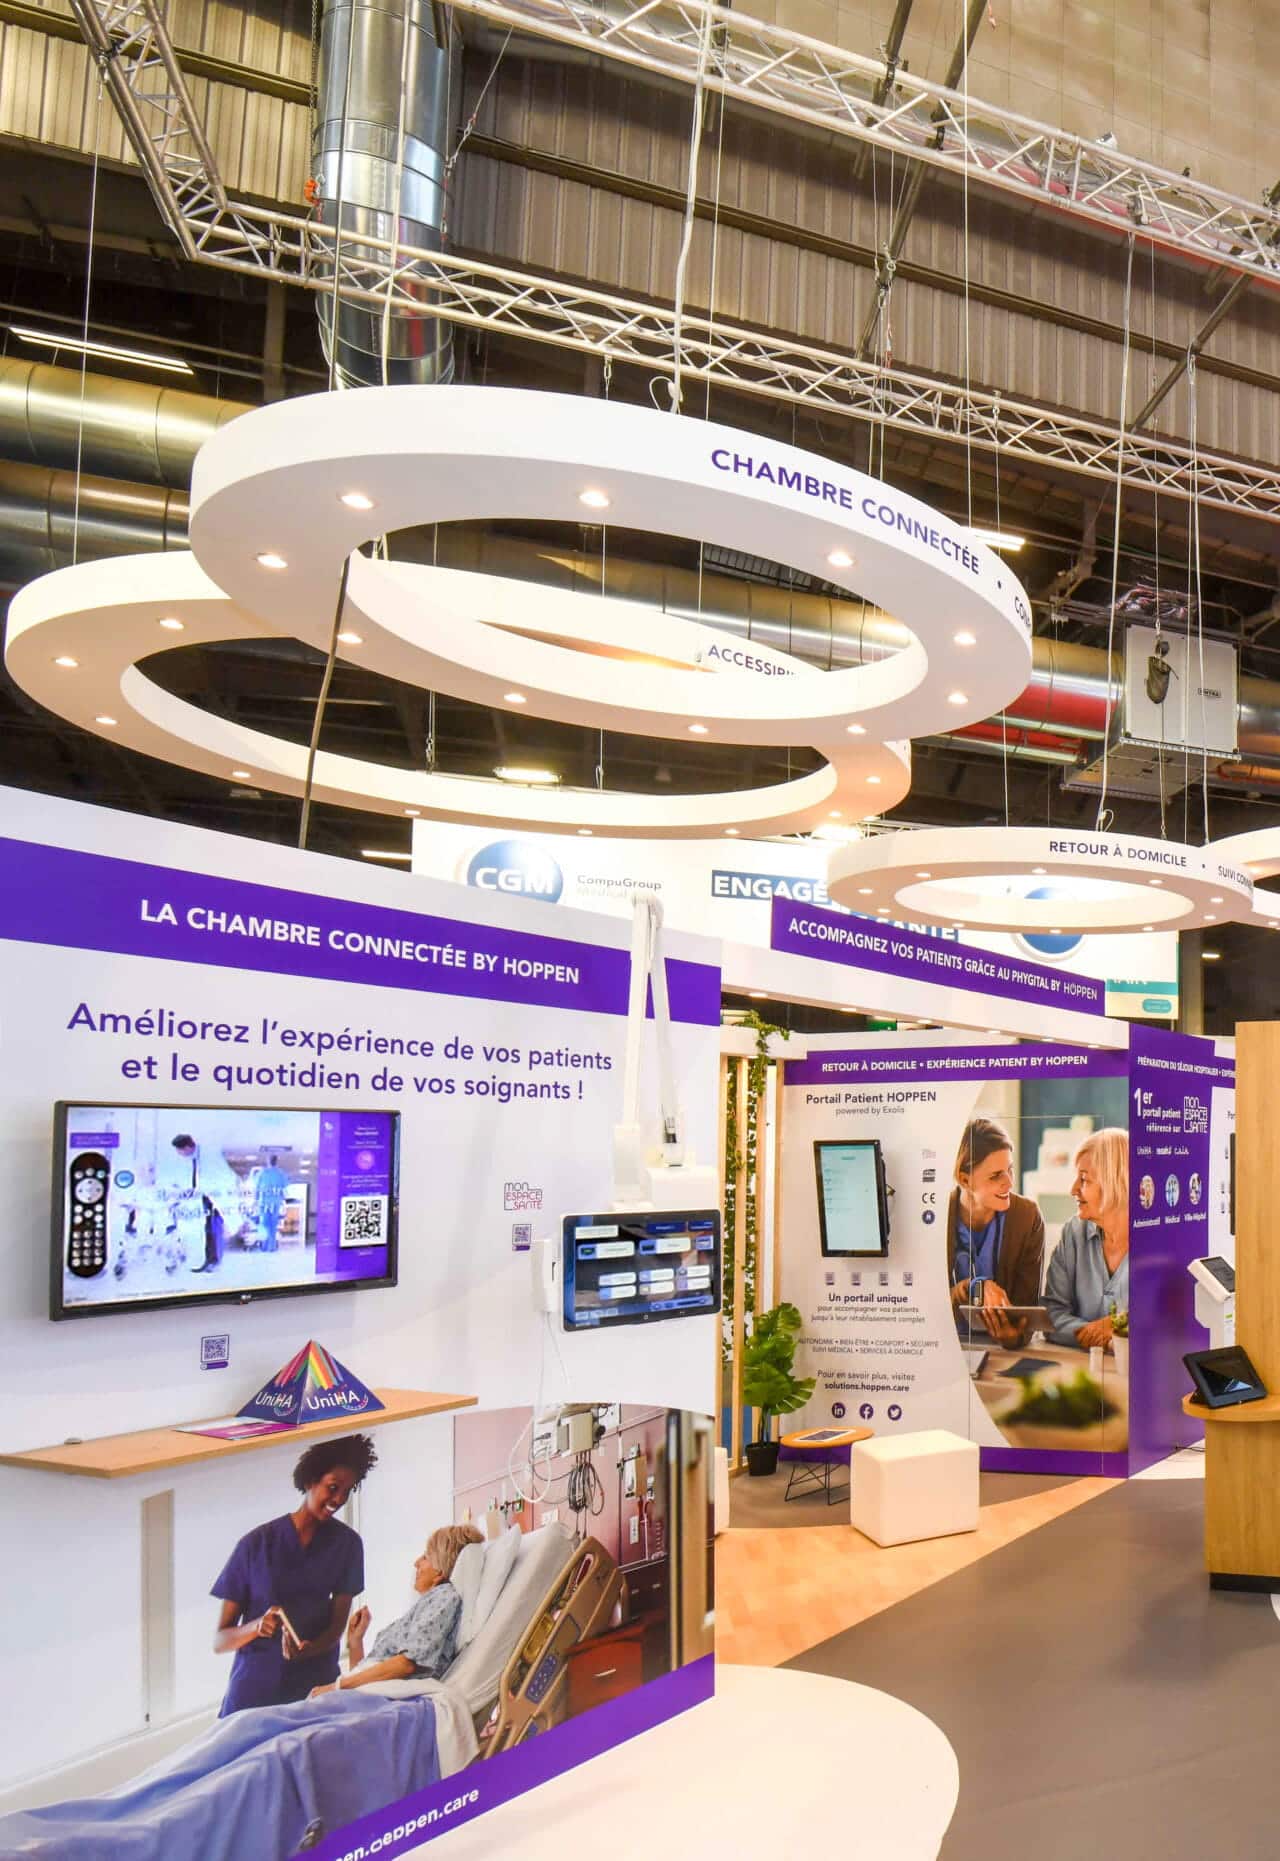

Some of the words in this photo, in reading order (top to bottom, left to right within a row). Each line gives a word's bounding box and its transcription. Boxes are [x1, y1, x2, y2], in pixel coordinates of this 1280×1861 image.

[711, 449, 853, 510] CHAMBRE
[861, 498, 980, 575] CONNECTÉE
[1049, 840, 1109, 857] RETOUR
[1113, 843, 1123, 857] À
[1127, 847, 1188, 868] DOMICILE
[475, 867, 553, 894] CGM
[577, 874, 662, 892] CompuGroup
[140, 899, 178, 926] LA
[186, 907, 321, 946] CHAMBRE
[328, 930, 467, 968] CONNECTÉE
[472, 953, 498, 973] BY
[503, 956, 579, 985] HOPPEN
[788, 917, 888, 954] ACCOMPAGNEZ
[890, 941, 914, 960] VOS
[915, 947, 963, 972] PATIENTS
[964, 955, 996, 979] GRÂCE
[997, 966, 1011, 981] AU
[1012, 970, 1050, 990] PHYGITAL
[1050, 978, 1061, 992] BY
[1063, 982, 1098, 1001] HOPPEN
[66, 1002, 249, 1046] Améliorez
[261, 1018, 434, 1057] l'expérience
[444, 1036, 474, 1061] de
[482, 1046, 521, 1064] vos
[528, 1046, 612, 1073] patients
[822, 1062, 859, 1072] RETOUR
[861, 1059, 869, 1071] À
[870, 1060, 917, 1071] DOMICILE
[926, 1057, 987, 1069] EXPÉRIENCE
[988, 1056, 1028, 1067] PATIENT
[1030, 1056, 1044, 1066] BY
[1045, 1055, 1088, 1066] HOPPEN
[121, 1055, 158, 1081] et
[172, 1053, 200, 1082] le
[213, 1060, 360, 1091] quotidien
[371, 1067, 402, 1092] de
[413, 1075, 455, 1095] vos
[464, 1075, 571, 1103] soignants
[806, 1094, 841, 1104] Portail
[845, 1093, 884, 1103] Patient
[887, 1091, 937, 1102] HOPPEN
[836, 1107, 869, 1115] powered
[871, 1106, 881, 1115] by
[828, 1293, 841, 1302] Un
[844, 1293, 874, 1304] portail
[877, 1294, 908, 1304] unique
[818, 1370, 835, 1378] Pour
[848, 1371, 869, 1379] savoir
[891, 1372, 915, 1381] visitez
[825, 1382, 910, 1392] solutions.hoppen.care
[255, 1390, 293, 1408] UniHA
[306, 1389, 361, 1410] UniHA
